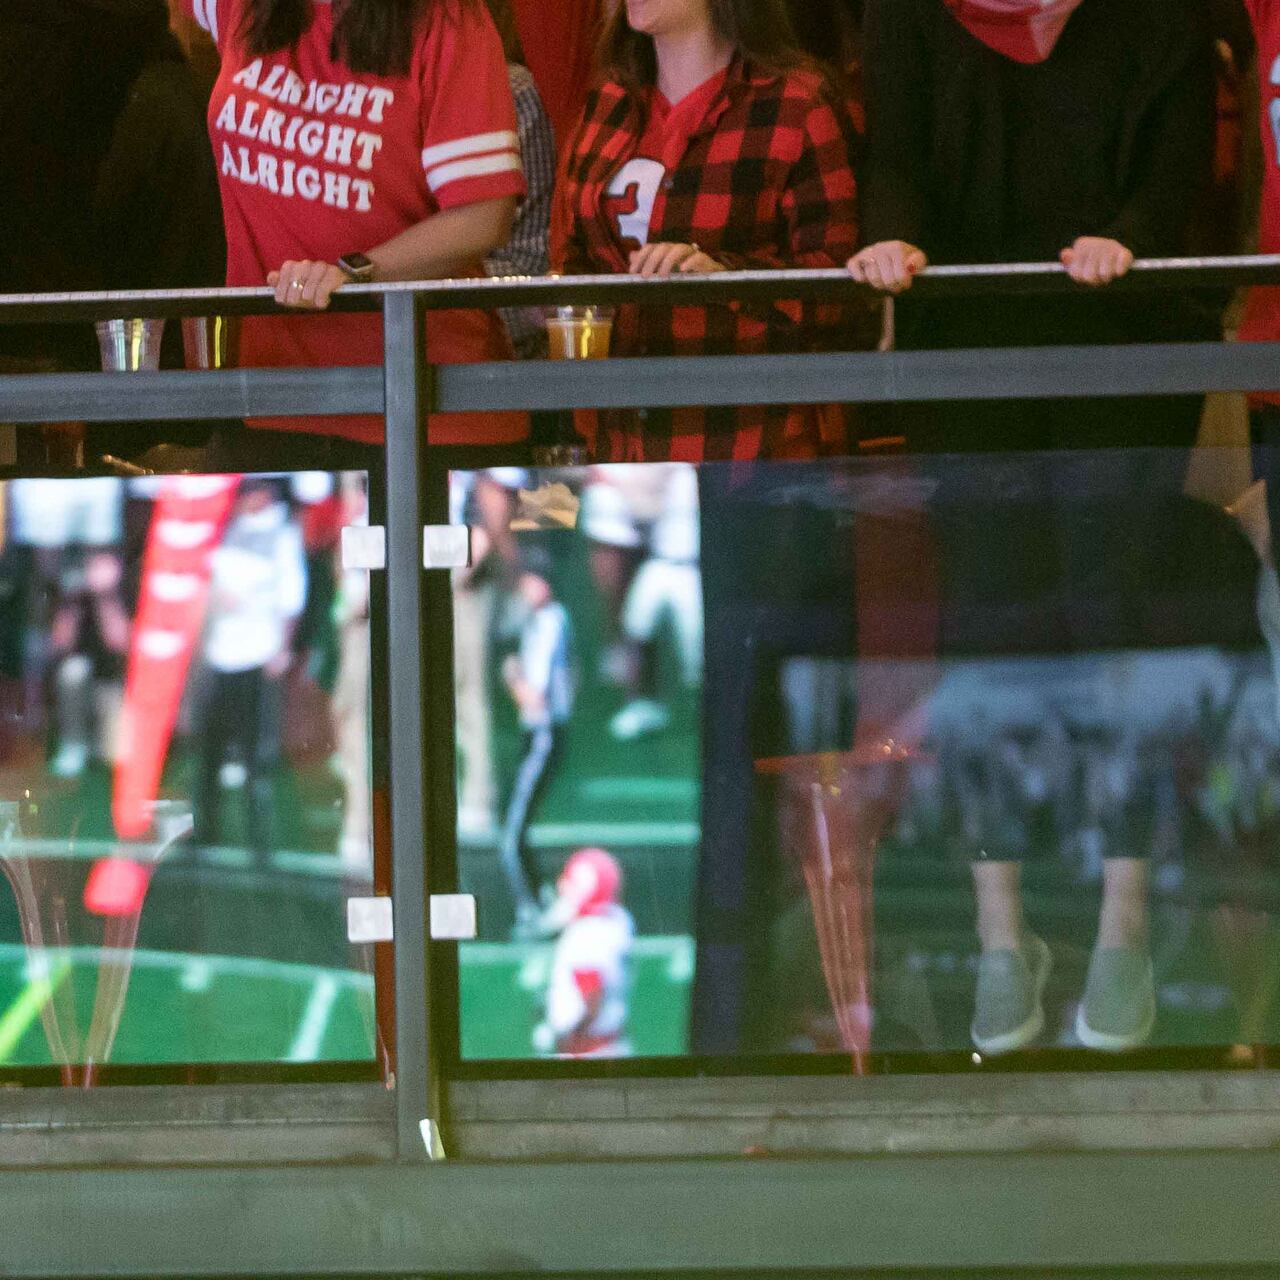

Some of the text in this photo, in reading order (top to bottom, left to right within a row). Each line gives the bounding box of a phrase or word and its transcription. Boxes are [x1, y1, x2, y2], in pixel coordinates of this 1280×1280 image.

[232, 57, 395, 124] ALRIGHT
[215, 93, 383, 171] ALRIGHT
[221, 140, 376, 213] ALRIGHT
